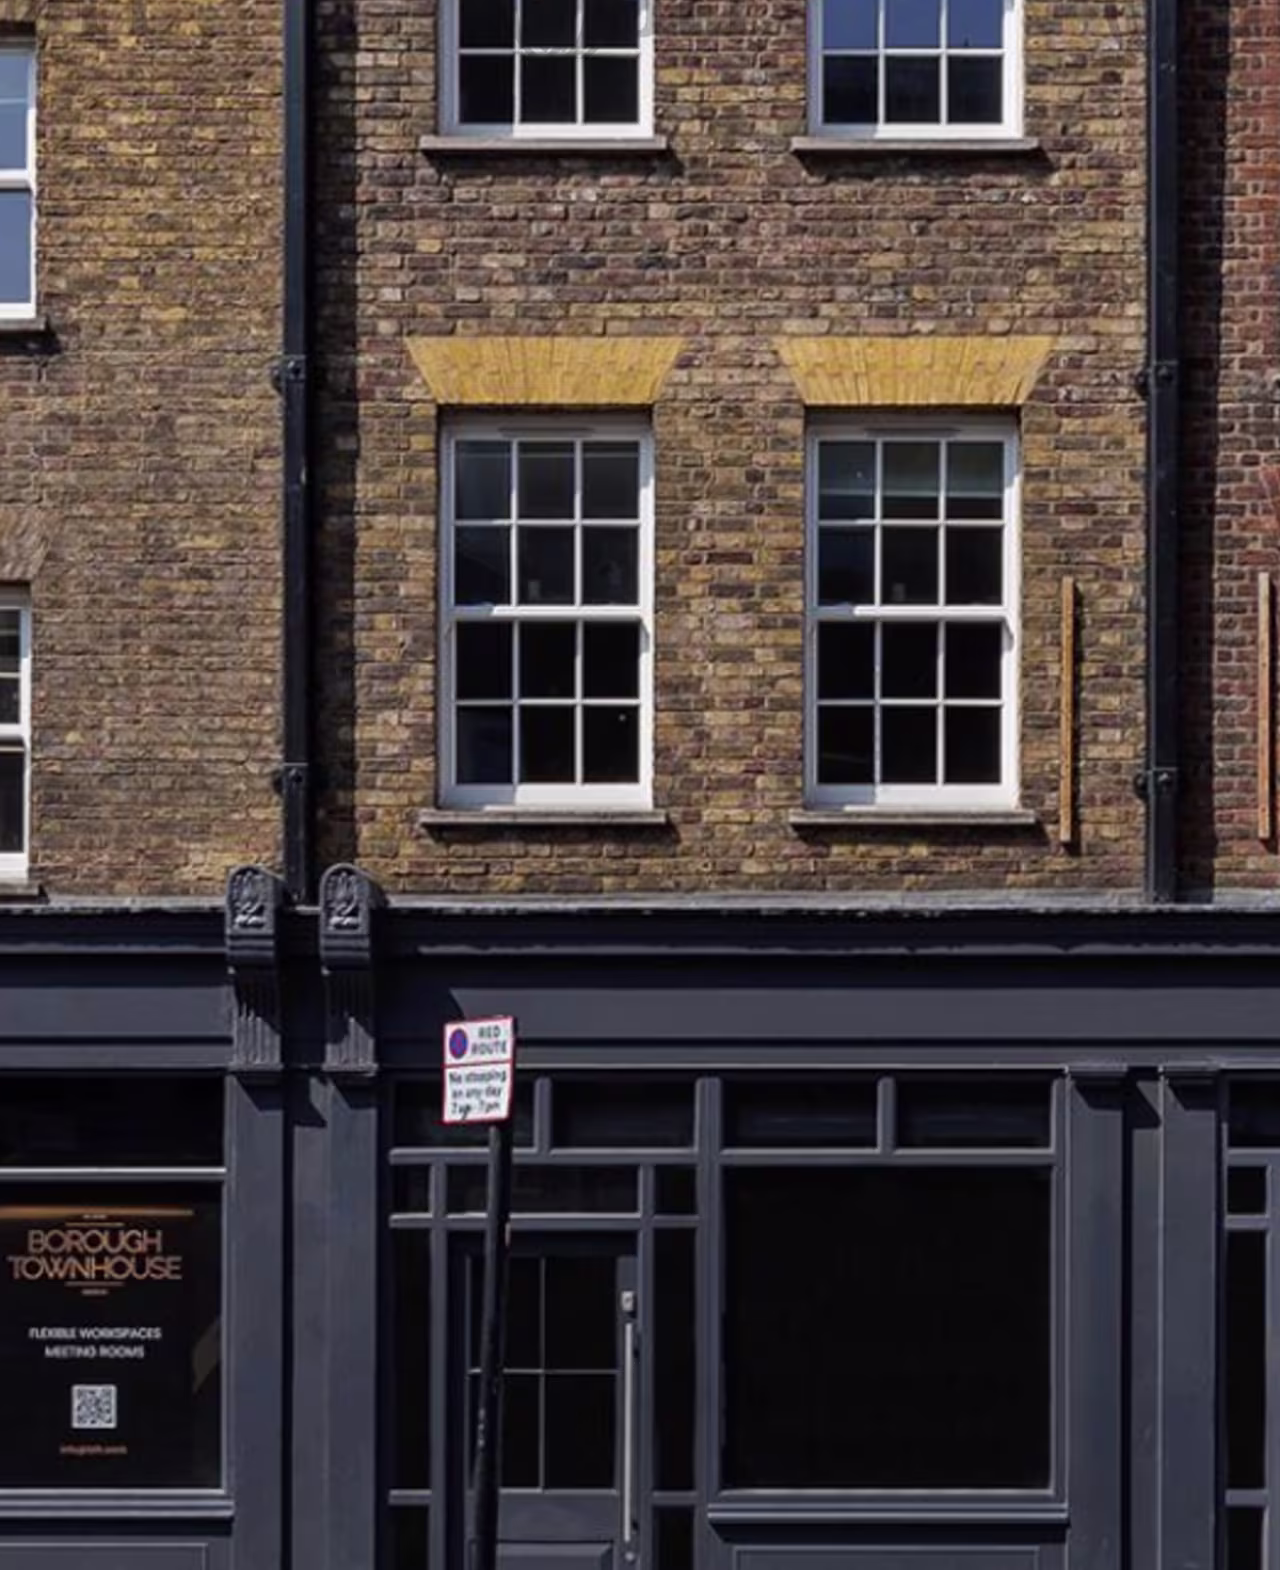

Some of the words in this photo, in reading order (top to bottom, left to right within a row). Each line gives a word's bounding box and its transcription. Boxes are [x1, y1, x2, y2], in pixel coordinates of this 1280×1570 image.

[478, 1025, 501, 1039] RED
[471, 1040, 507, 1055] ROUTE
[28, 1229, 162, 1253] BOROUGH
[6, 1256, 183, 1280] TOWNHOUSE
[28, 1327, 77, 1339] FLEXIBLE
[79, 1327, 162, 1339] WORKSPACES
[44, 1345, 97, 1358] MEETING
[99, 1345, 145, 1358] ROOMS
